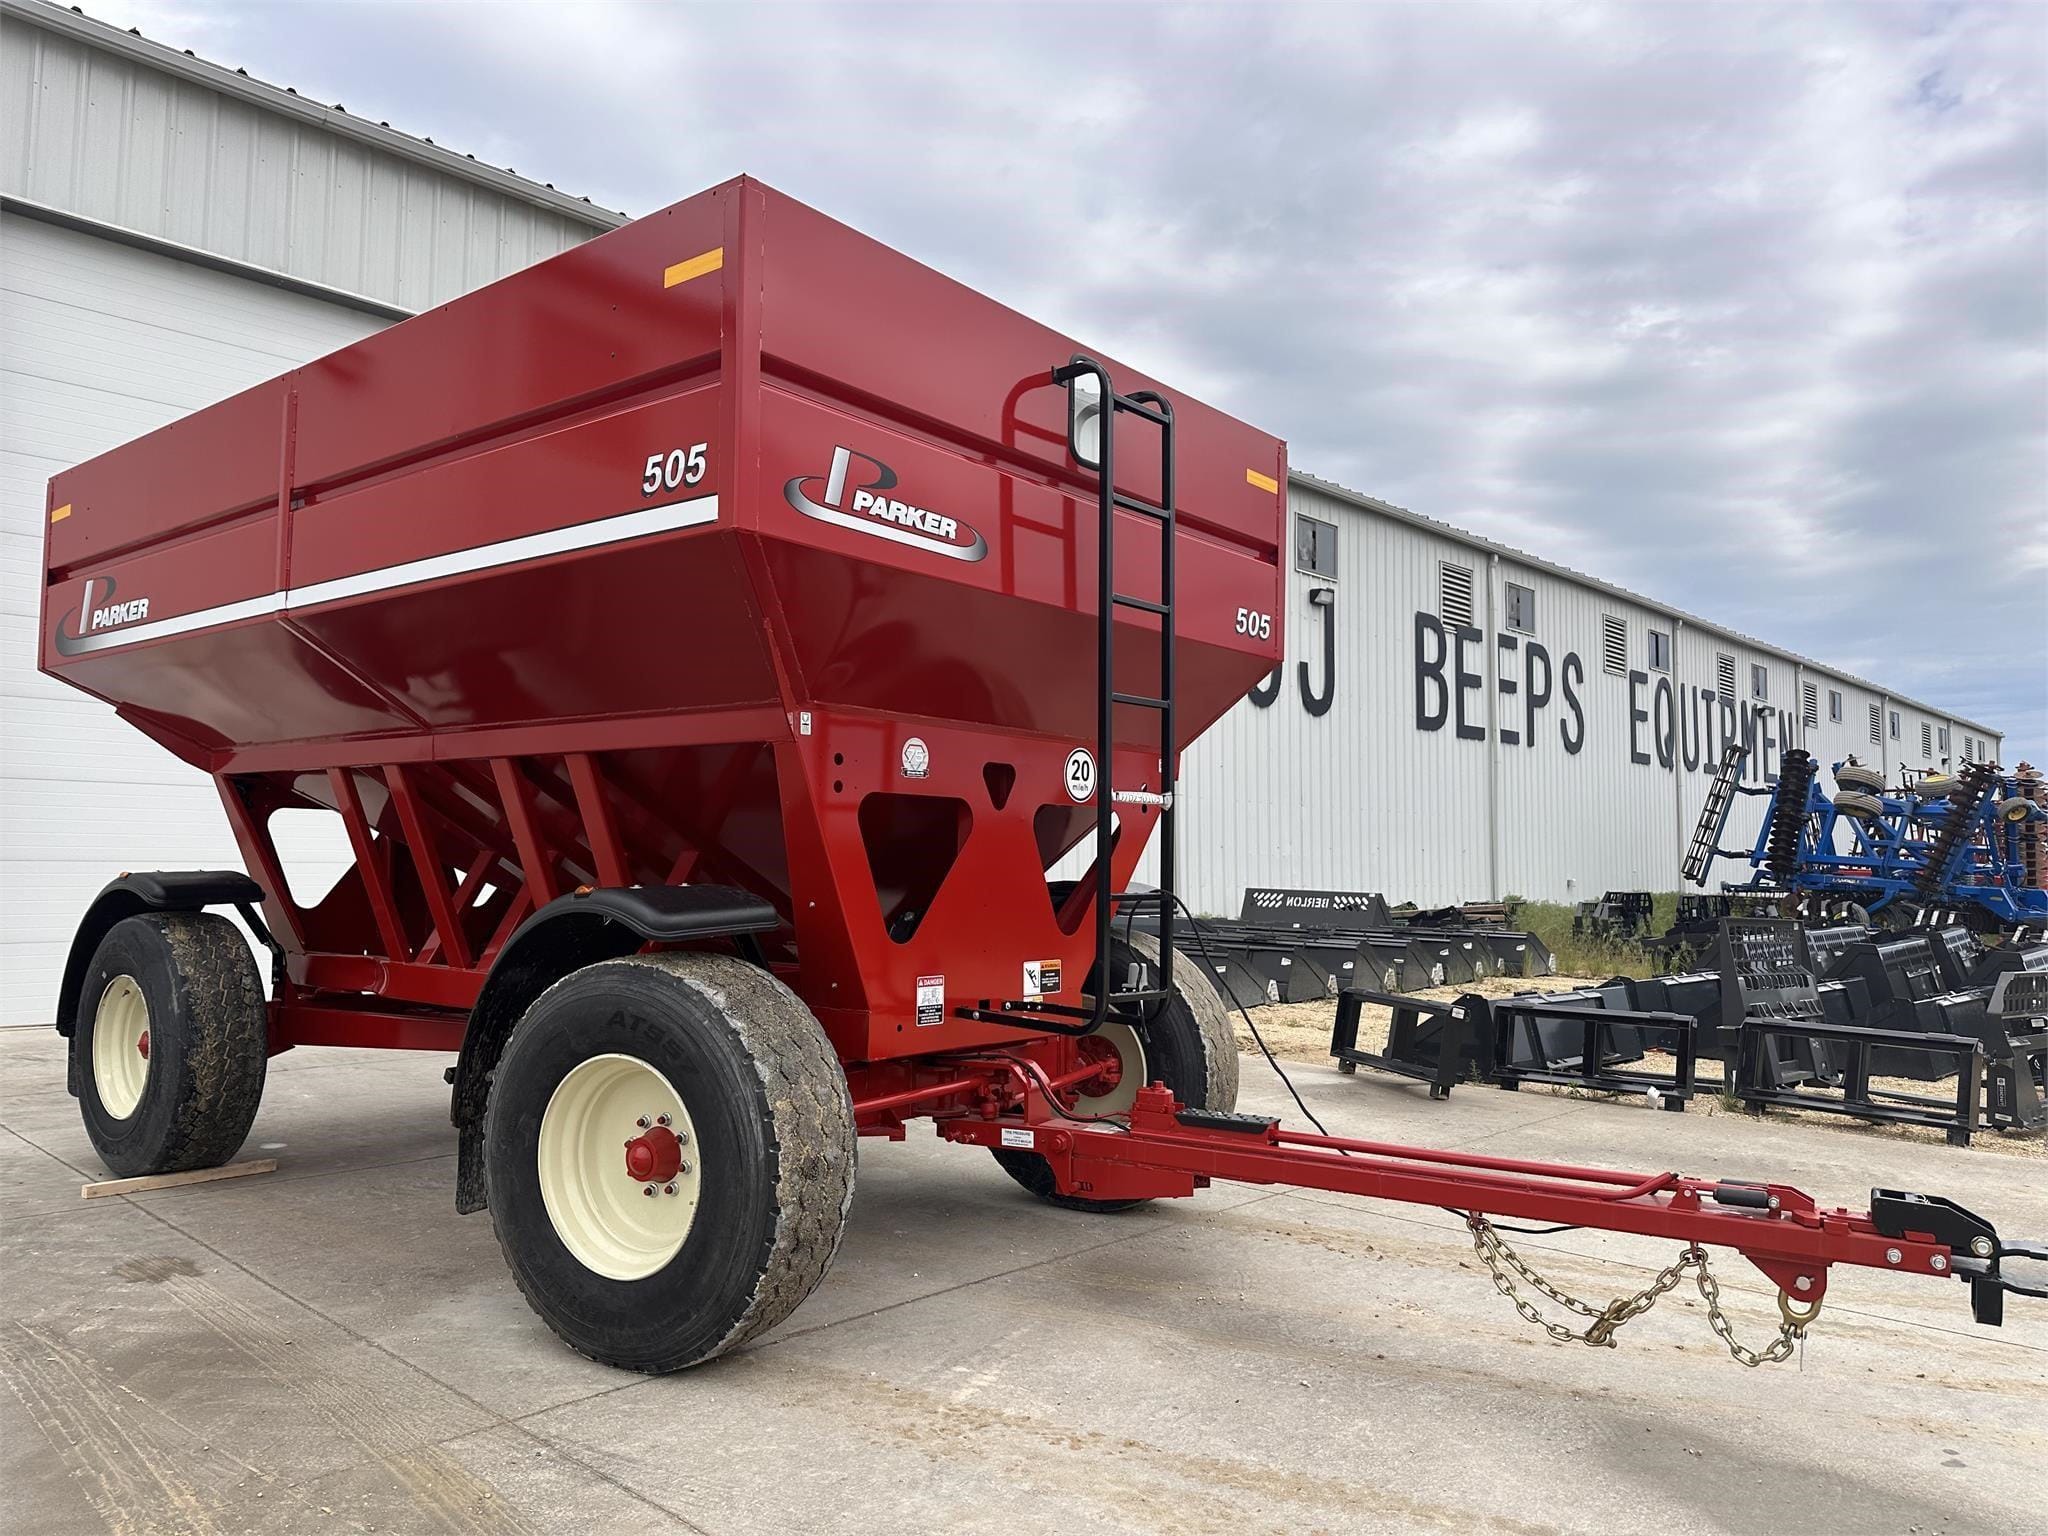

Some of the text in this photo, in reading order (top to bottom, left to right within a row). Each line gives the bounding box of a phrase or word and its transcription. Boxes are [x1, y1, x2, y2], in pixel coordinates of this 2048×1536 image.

[642, 442, 708, 496] 505
[852, 489, 958, 540] PARKER
[92, 598, 149, 630] PARKER
[1235, 607, 1271, 640] 505
[1415, 610, 1585, 756] BEEPS
[1071, 759, 1090, 782] 20
